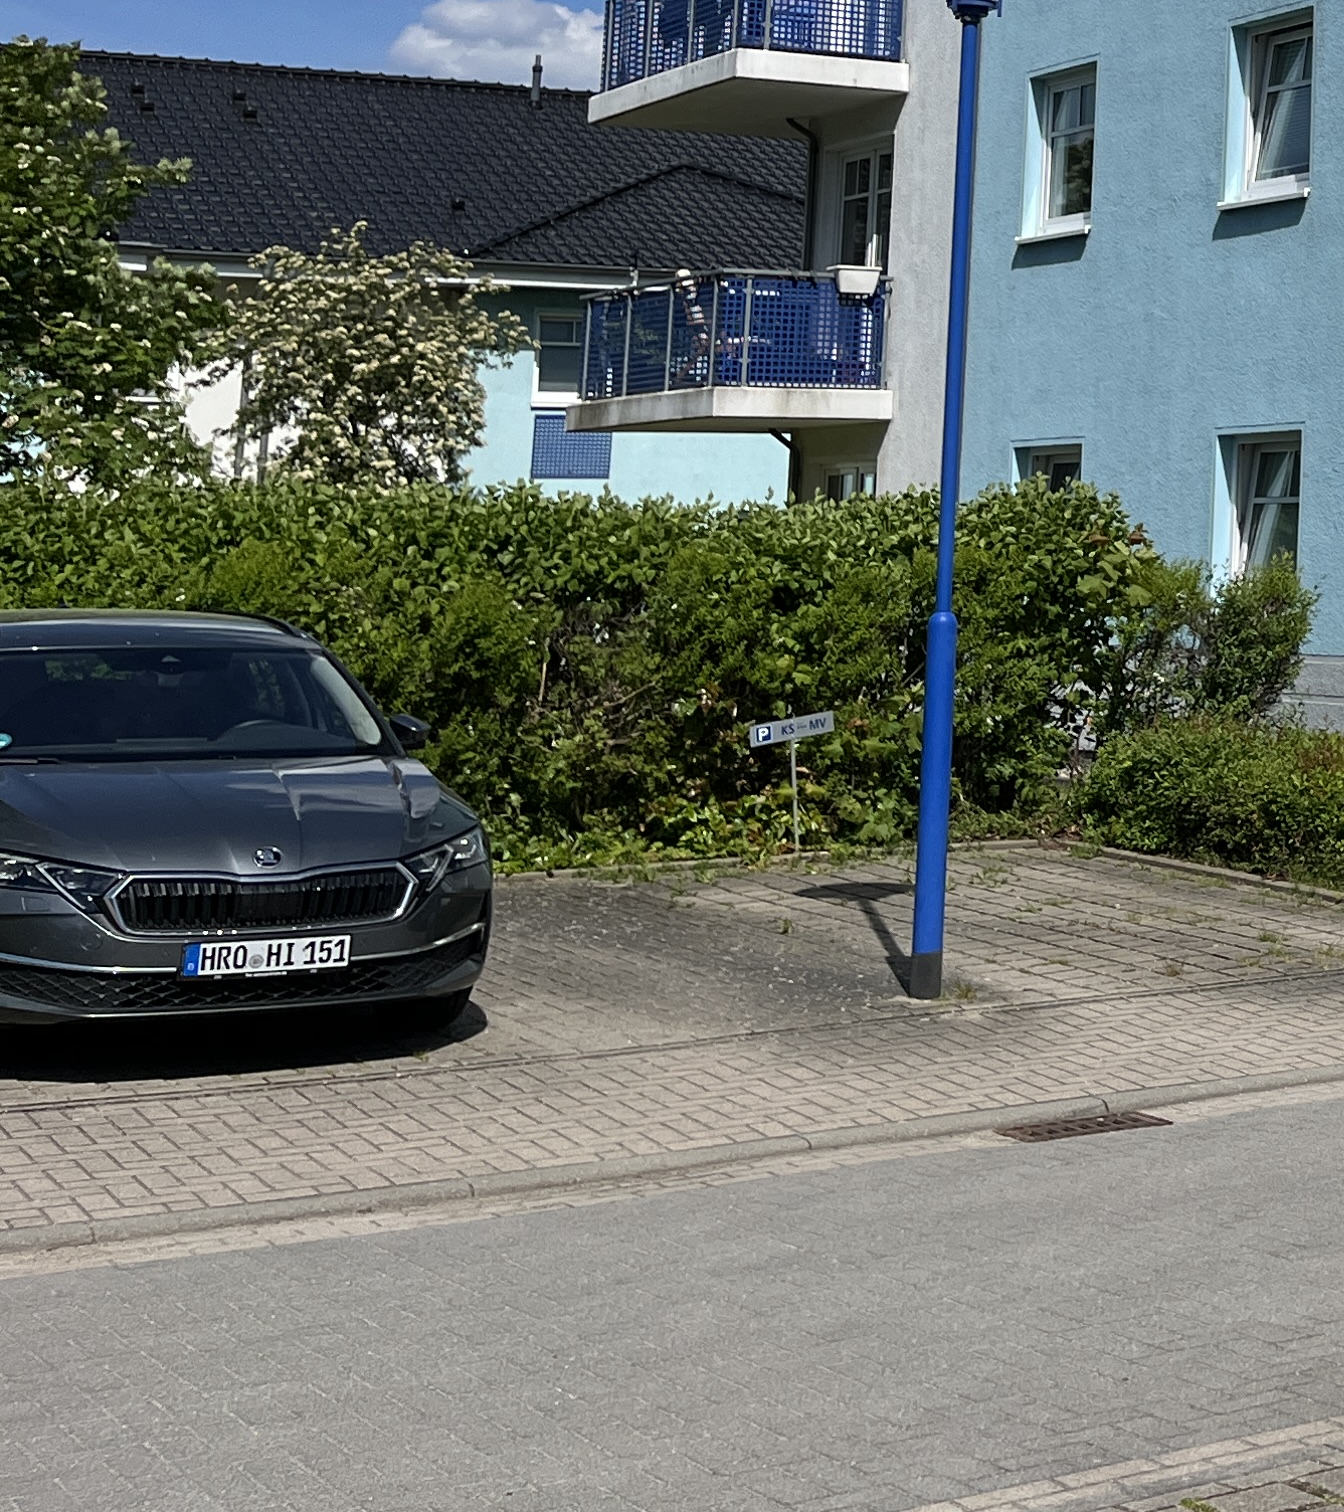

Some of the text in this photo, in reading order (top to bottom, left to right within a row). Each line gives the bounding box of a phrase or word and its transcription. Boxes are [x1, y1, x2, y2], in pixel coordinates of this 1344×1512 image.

[758, 727, 769, 742] P
[780, 723, 795, 735] KS
[808, 717, 827, 731] MV
[200, 939, 347, 971] HRO HI 151
